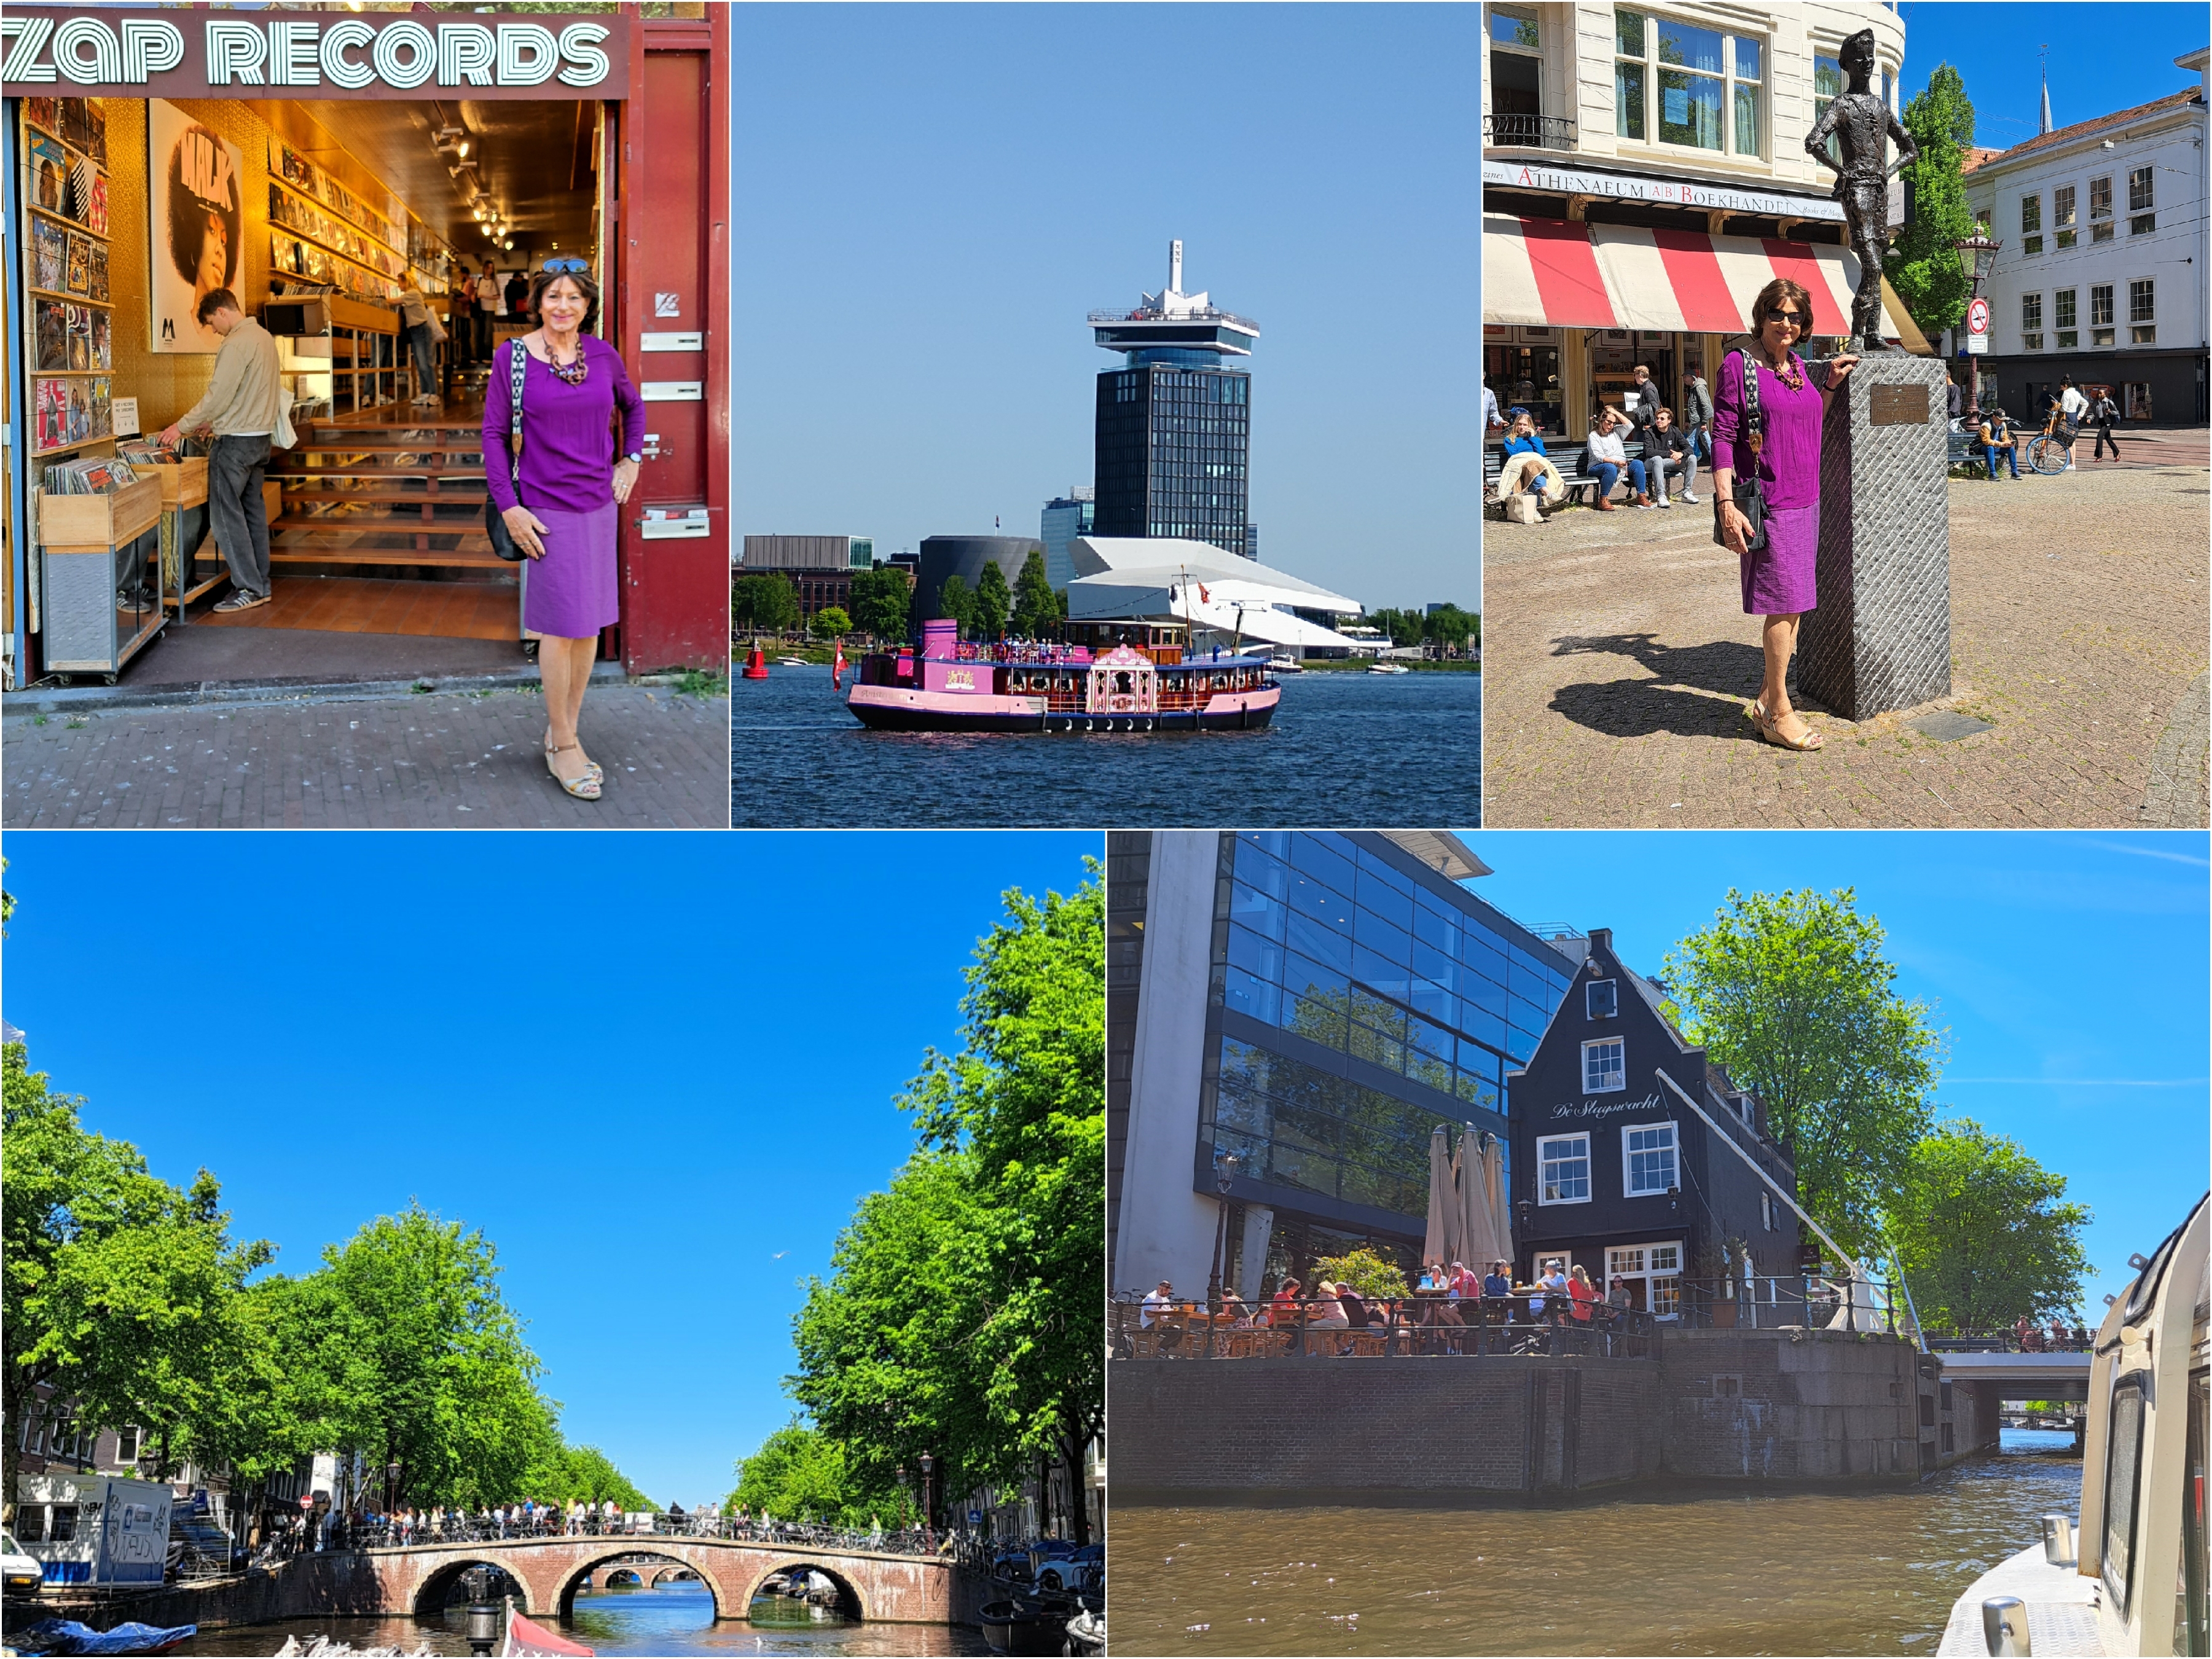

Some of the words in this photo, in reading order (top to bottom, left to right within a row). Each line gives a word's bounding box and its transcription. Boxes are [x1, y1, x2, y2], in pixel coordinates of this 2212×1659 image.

[206, 20, 610, 88] RECORDS
[1518, 168, 1644, 198] ATHENAEUM
[1681, 186, 1793, 214] BOEKHANDEL
[1550, 1102, 1572, 1119] De
[1574, 1093, 1660, 1119] Sluyswacht
